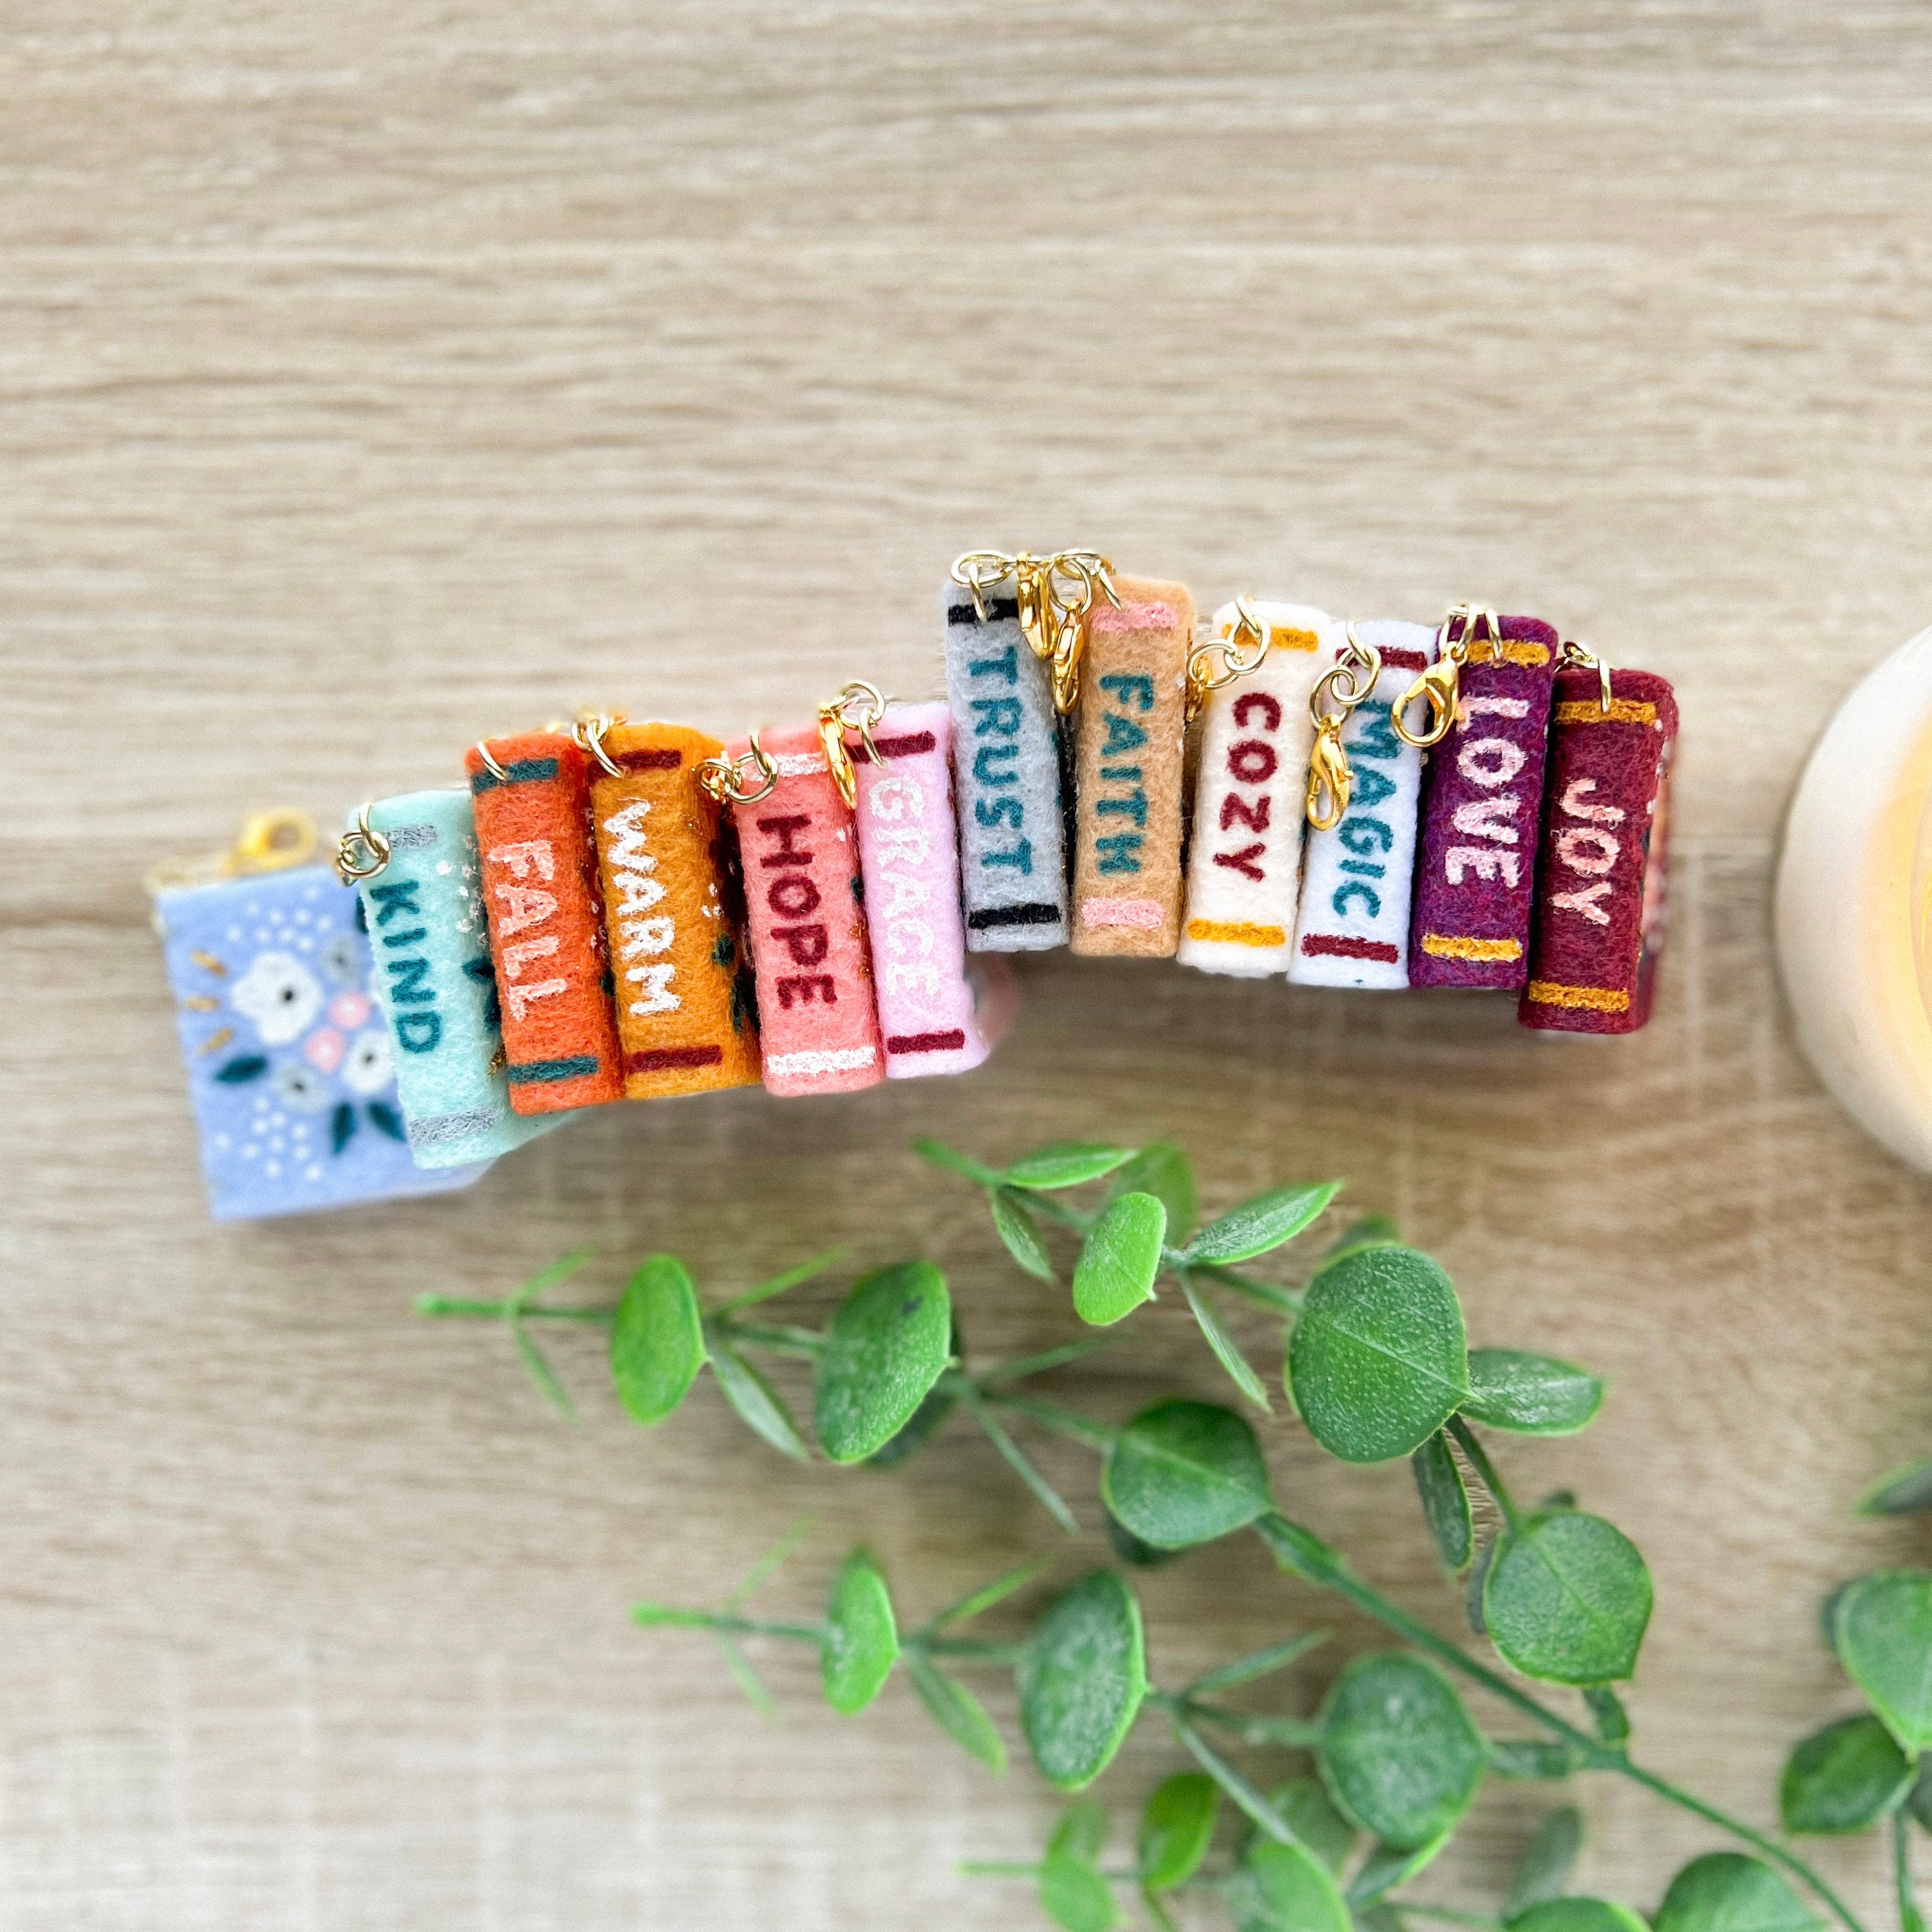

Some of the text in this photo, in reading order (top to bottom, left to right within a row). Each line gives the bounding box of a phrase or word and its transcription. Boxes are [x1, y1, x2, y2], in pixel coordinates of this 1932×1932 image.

[967, 646, 1032, 876] TRUST
[1095, 672, 1155, 876] FAITH
[1212, 692, 1282, 882] COZY
[1332, 699, 1408, 918] MAGIC
[1444, 696, 1531, 888] LOVE
[1548, 777, 1626, 925] JOY
[370, 878, 442, 1054] KIND
[488, 840, 569, 1021] FALL
[603, 798, 682, 1016] WARM
[757, 814, 837, 1010] HOPE
[869, 777, 940, 996] GRACE
